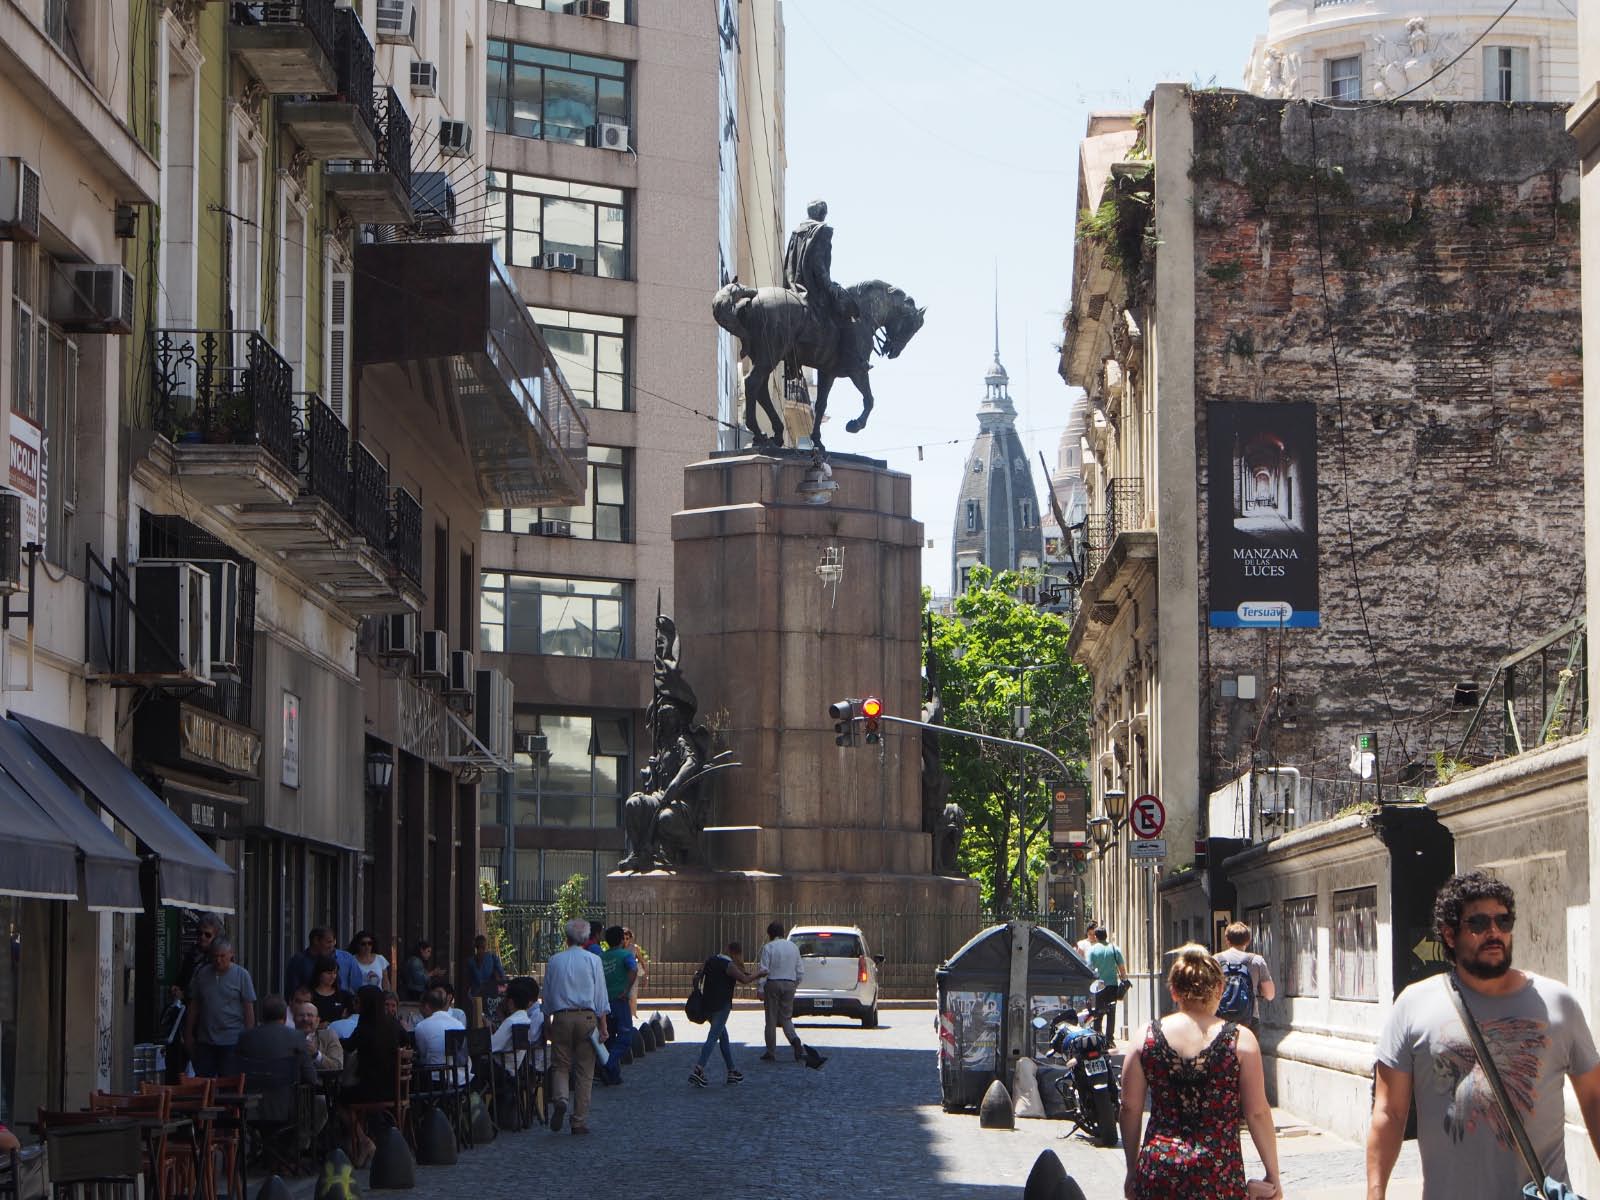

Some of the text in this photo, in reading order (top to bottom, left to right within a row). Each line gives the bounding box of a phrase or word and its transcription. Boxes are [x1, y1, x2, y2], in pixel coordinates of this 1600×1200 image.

[1233, 548, 1298, 559] MANZANA
[1245, 565, 1285, 576] LUCES
[1242, 607, 1288, 616] Tersuave
